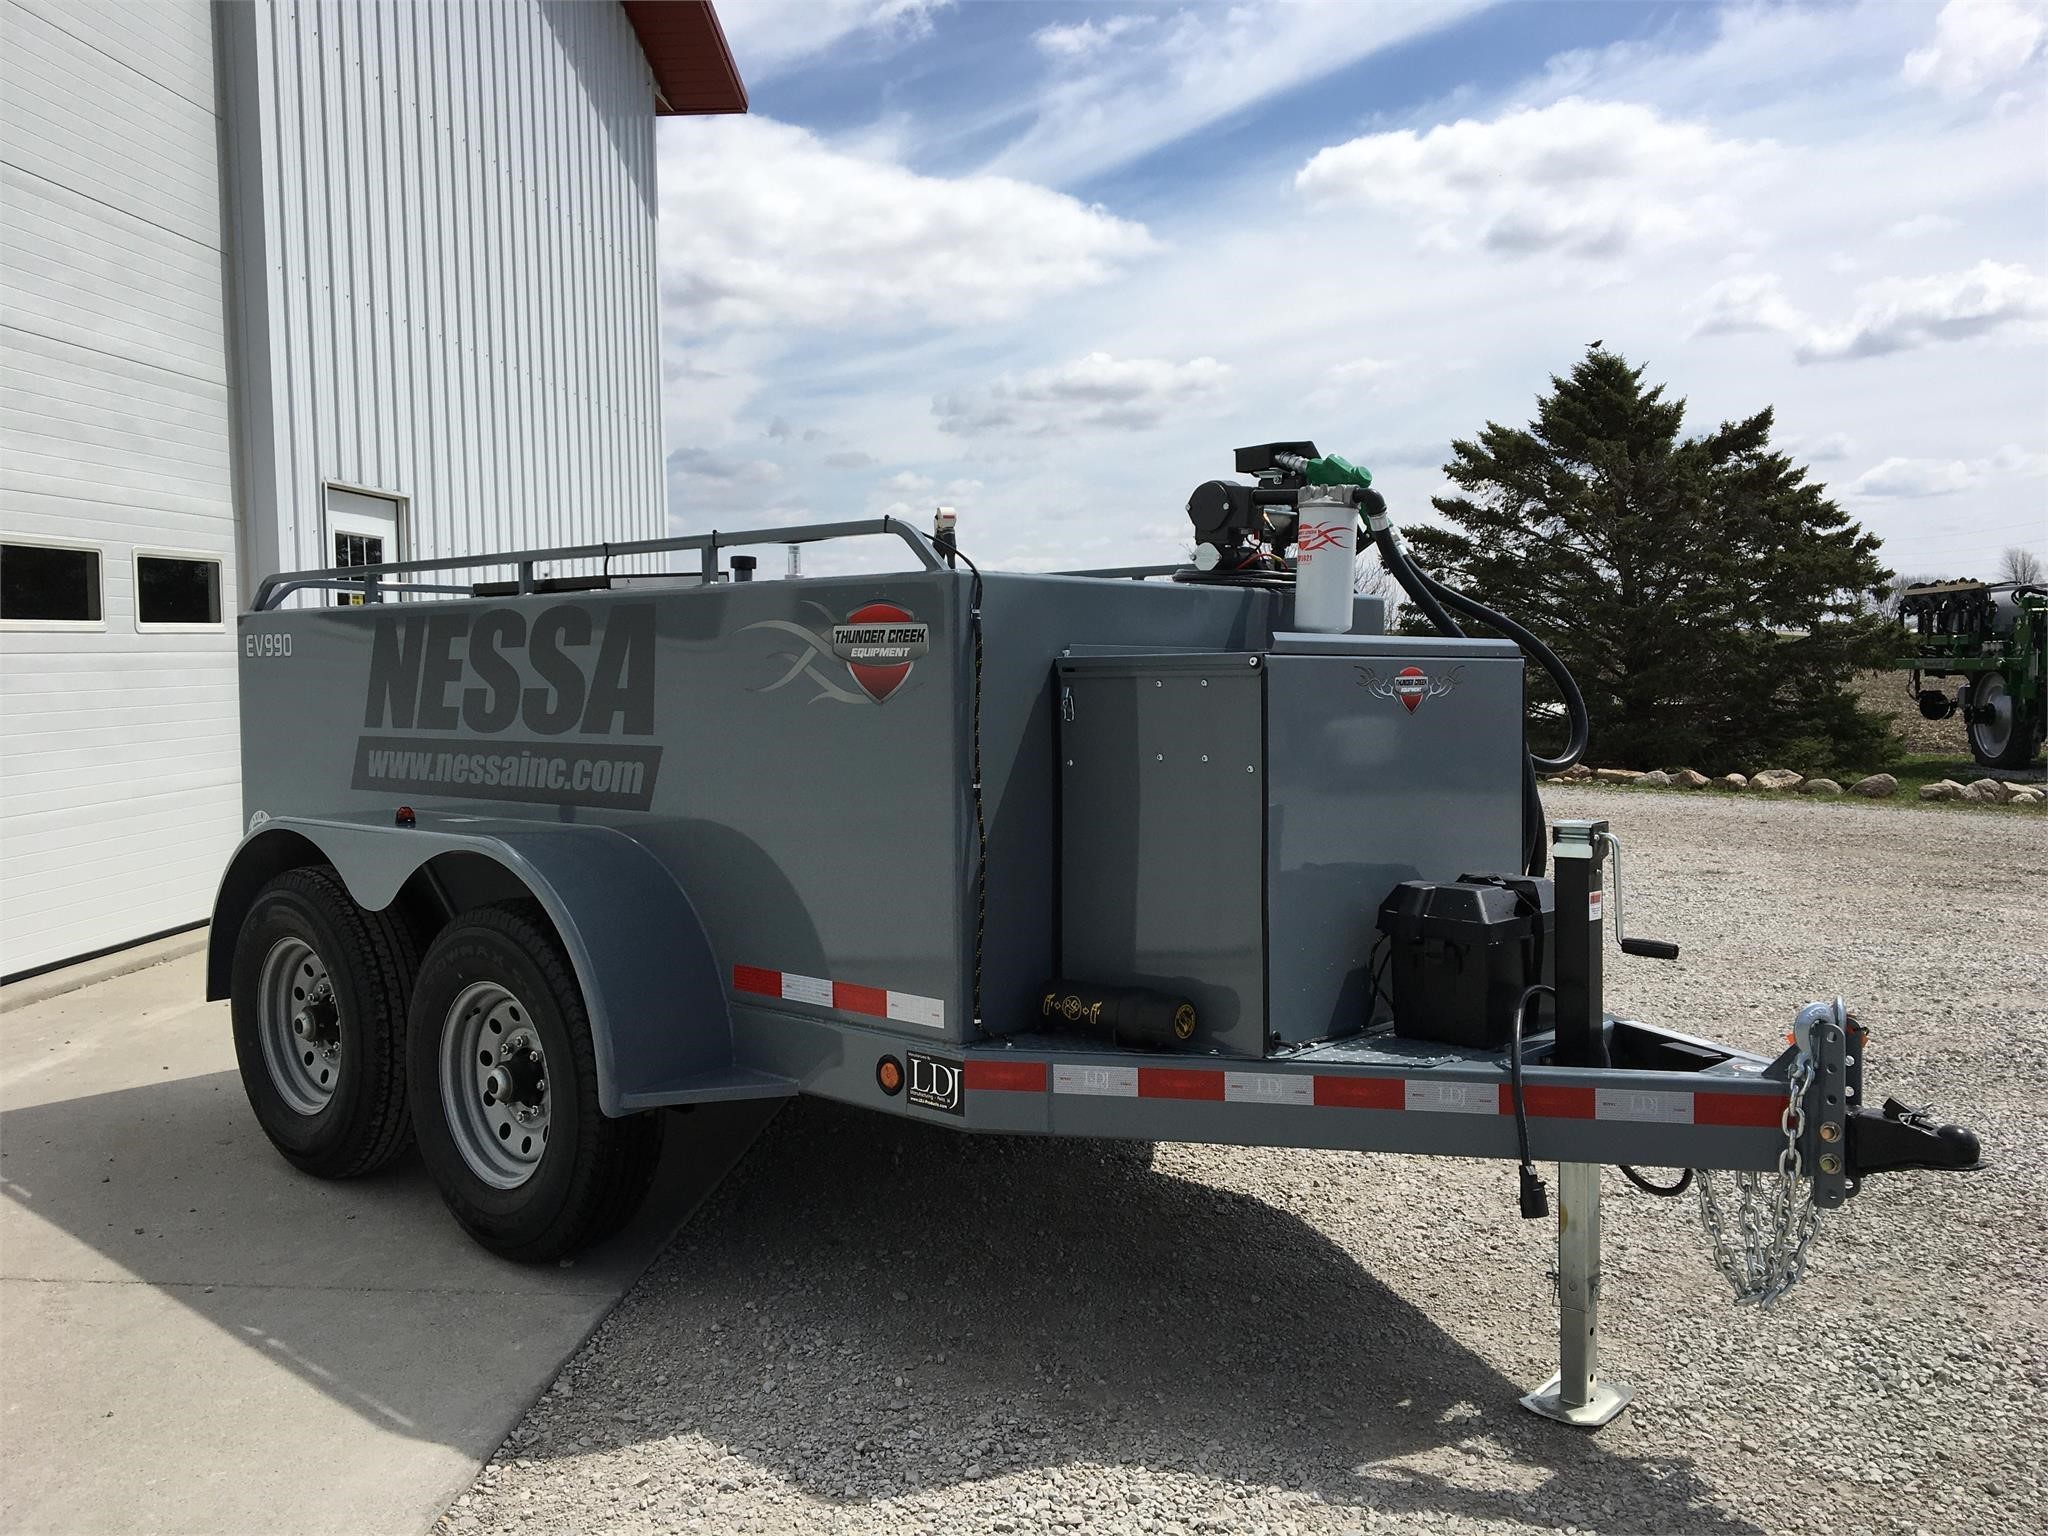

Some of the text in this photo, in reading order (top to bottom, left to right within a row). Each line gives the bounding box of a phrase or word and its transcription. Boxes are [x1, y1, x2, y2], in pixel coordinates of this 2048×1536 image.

[246, 634, 292, 657] EV990
[835, 628, 927, 644] THUNDER CREEK
[850, 647, 911, 657] EQUIPMENT
[364, 603, 656, 735] NESSA
[368, 750, 644, 795] www.nessainc.com
[910, 1058, 963, 1109] LDJ
